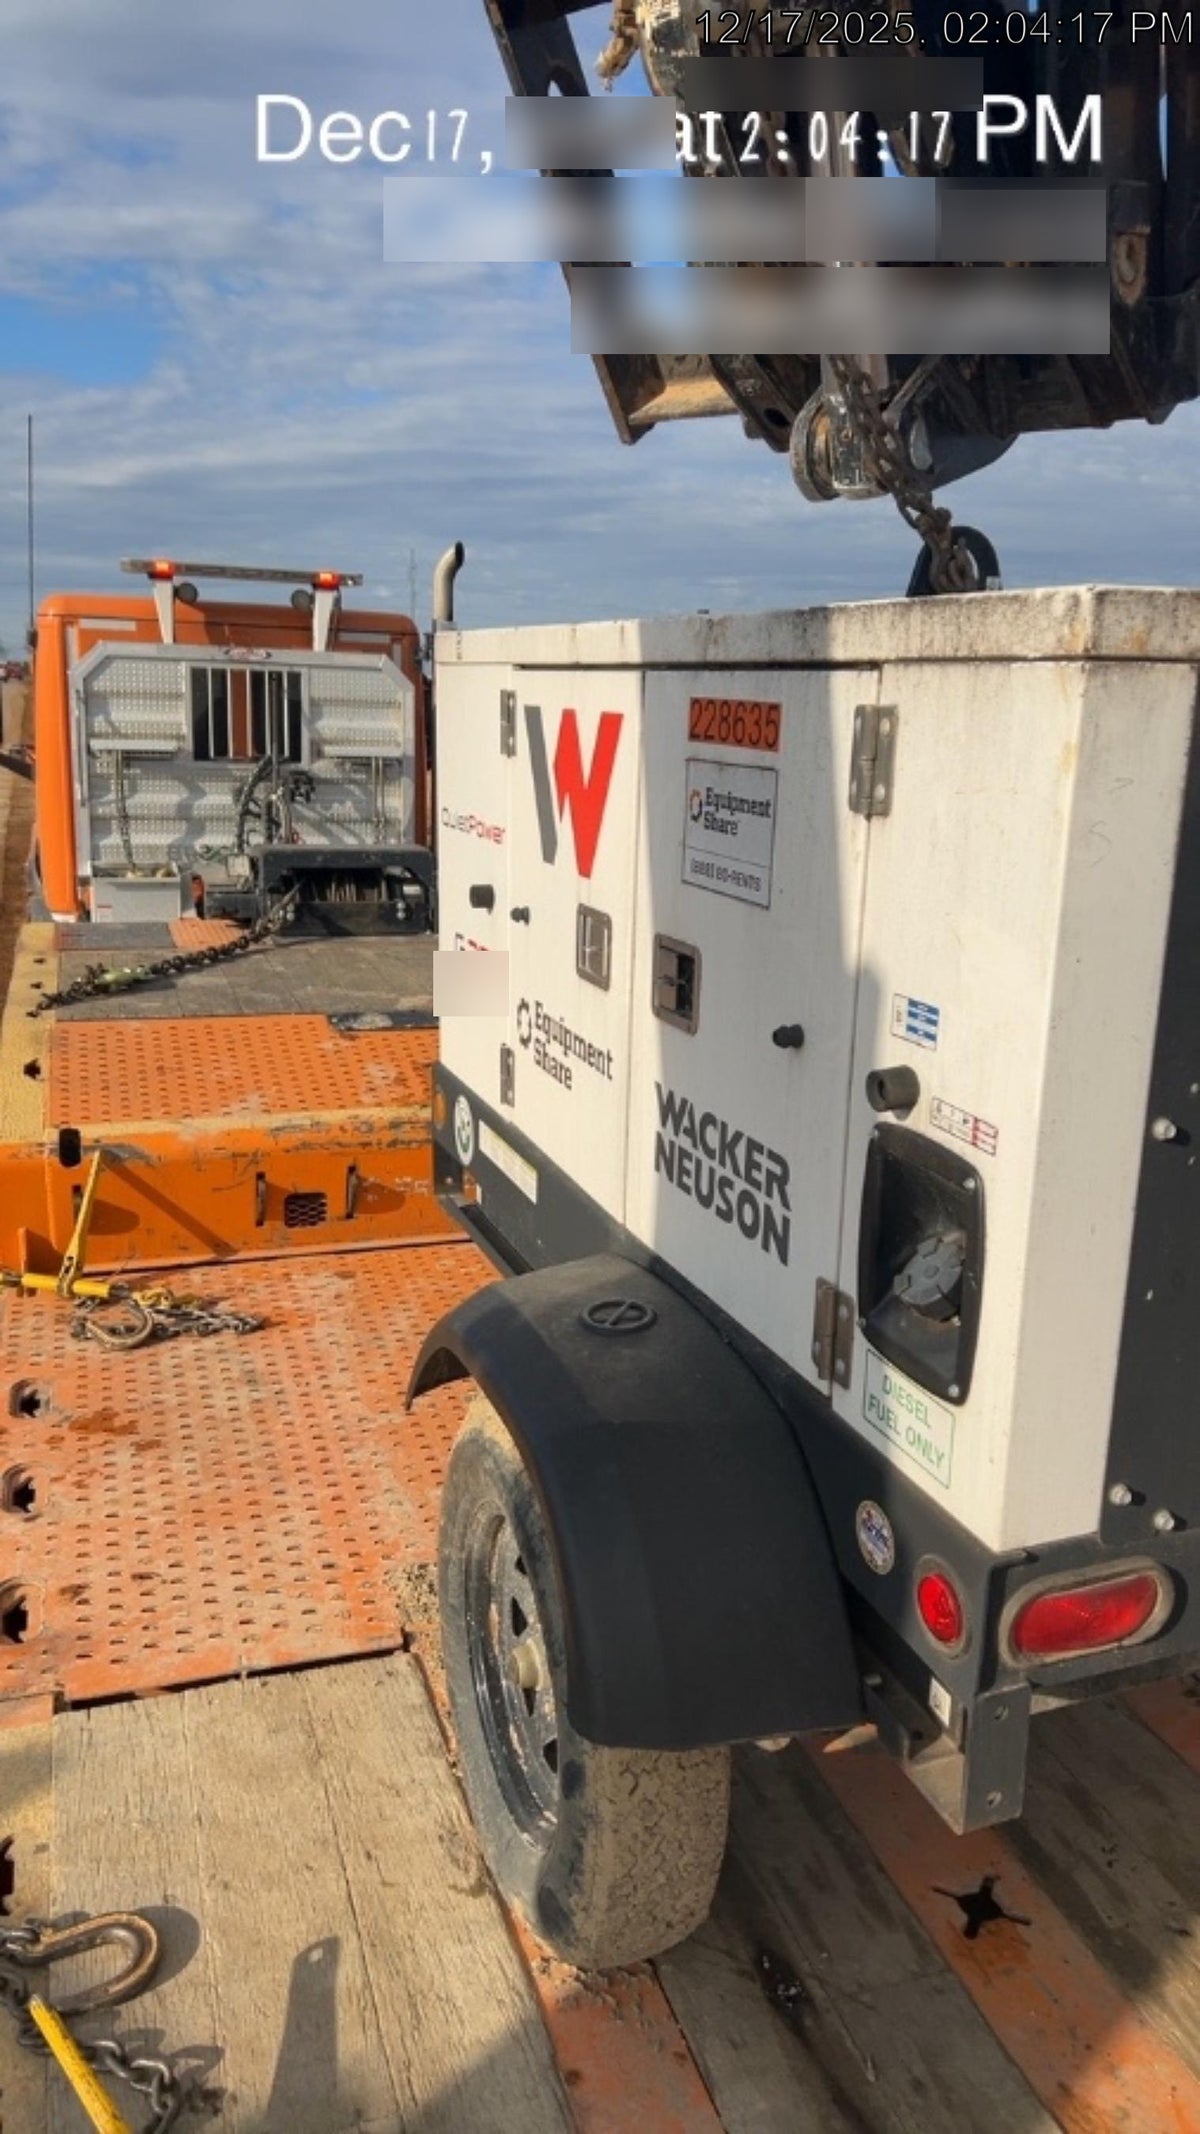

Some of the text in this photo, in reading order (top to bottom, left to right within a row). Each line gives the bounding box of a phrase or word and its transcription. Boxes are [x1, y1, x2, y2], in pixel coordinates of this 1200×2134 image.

[689, 699, 780, 748] 228635
[703, 811, 739, 836] Share
[705, 787, 772, 818] Equipment
[533, 1037, 572, 1091] Share
[535, 1000, 613, 1081] Equipment
[655, 1080, 792, 1212] WACKER
[655, 1130, 791, 1267] NEUSON
[882, 1374, 931, 1429] DIESEL
[868, 1393, 945, 1469] FUEL ONLY
